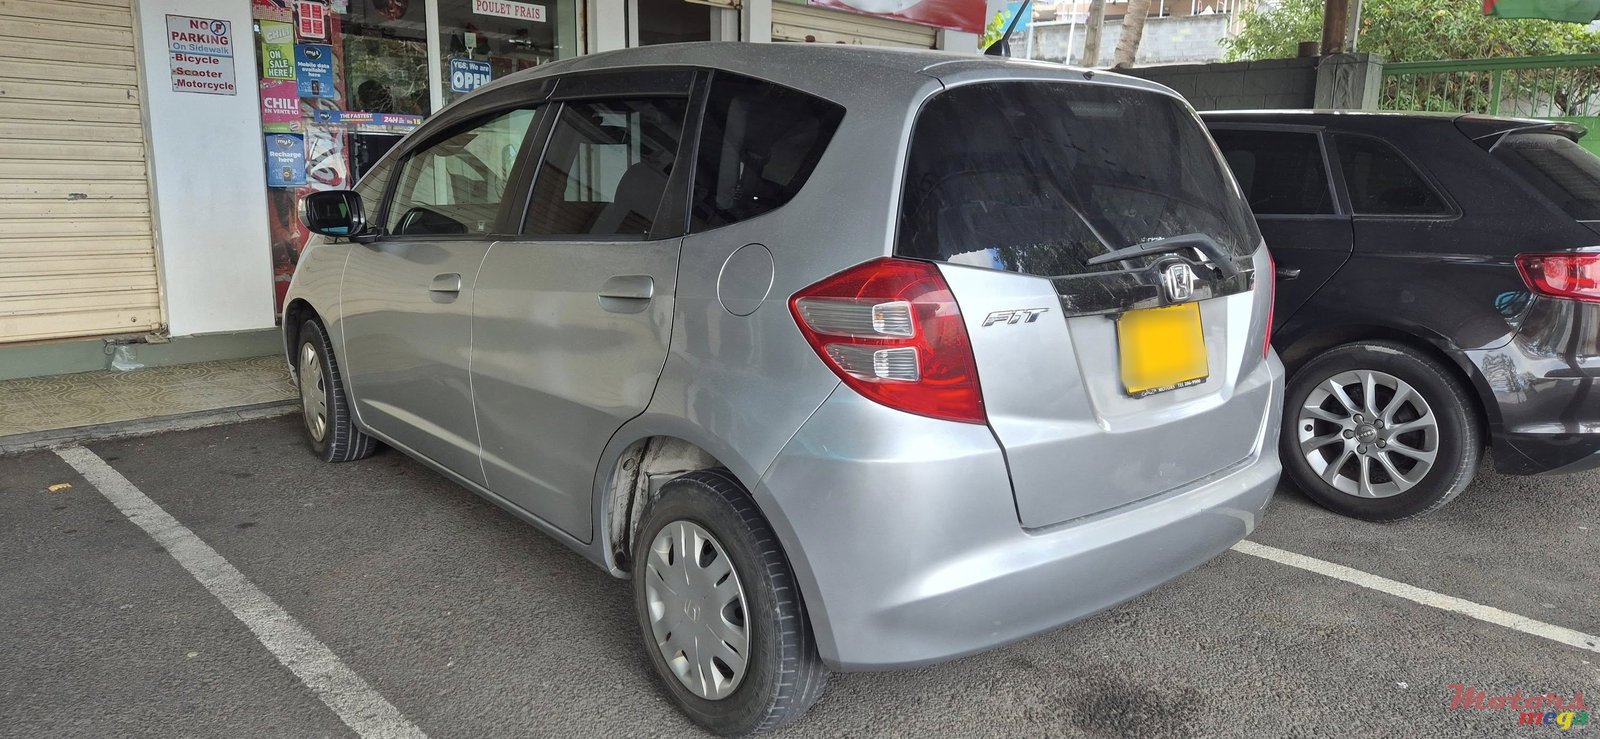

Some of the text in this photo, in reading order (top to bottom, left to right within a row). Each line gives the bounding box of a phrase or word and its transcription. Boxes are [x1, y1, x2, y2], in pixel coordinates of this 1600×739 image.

[476, 0, 541, 19] POULET FRAIS
[190, 19, 209, 30] NO
[171, 31, 229, 45] PARKING
[173, 42, 229, 54] On Sidewalk
[269, 50, 281, 59] ON
[269, 59, 289, 69] SALE
[301, 66, 327, 74] available
[469, 62, 479, 70] We
[268, 66, 293, 78] HERE!
[453, 71, 490, 89] OPEN
[264, 97, 299, 110] CHILI
[981, 308, 1049, 327] FIT
